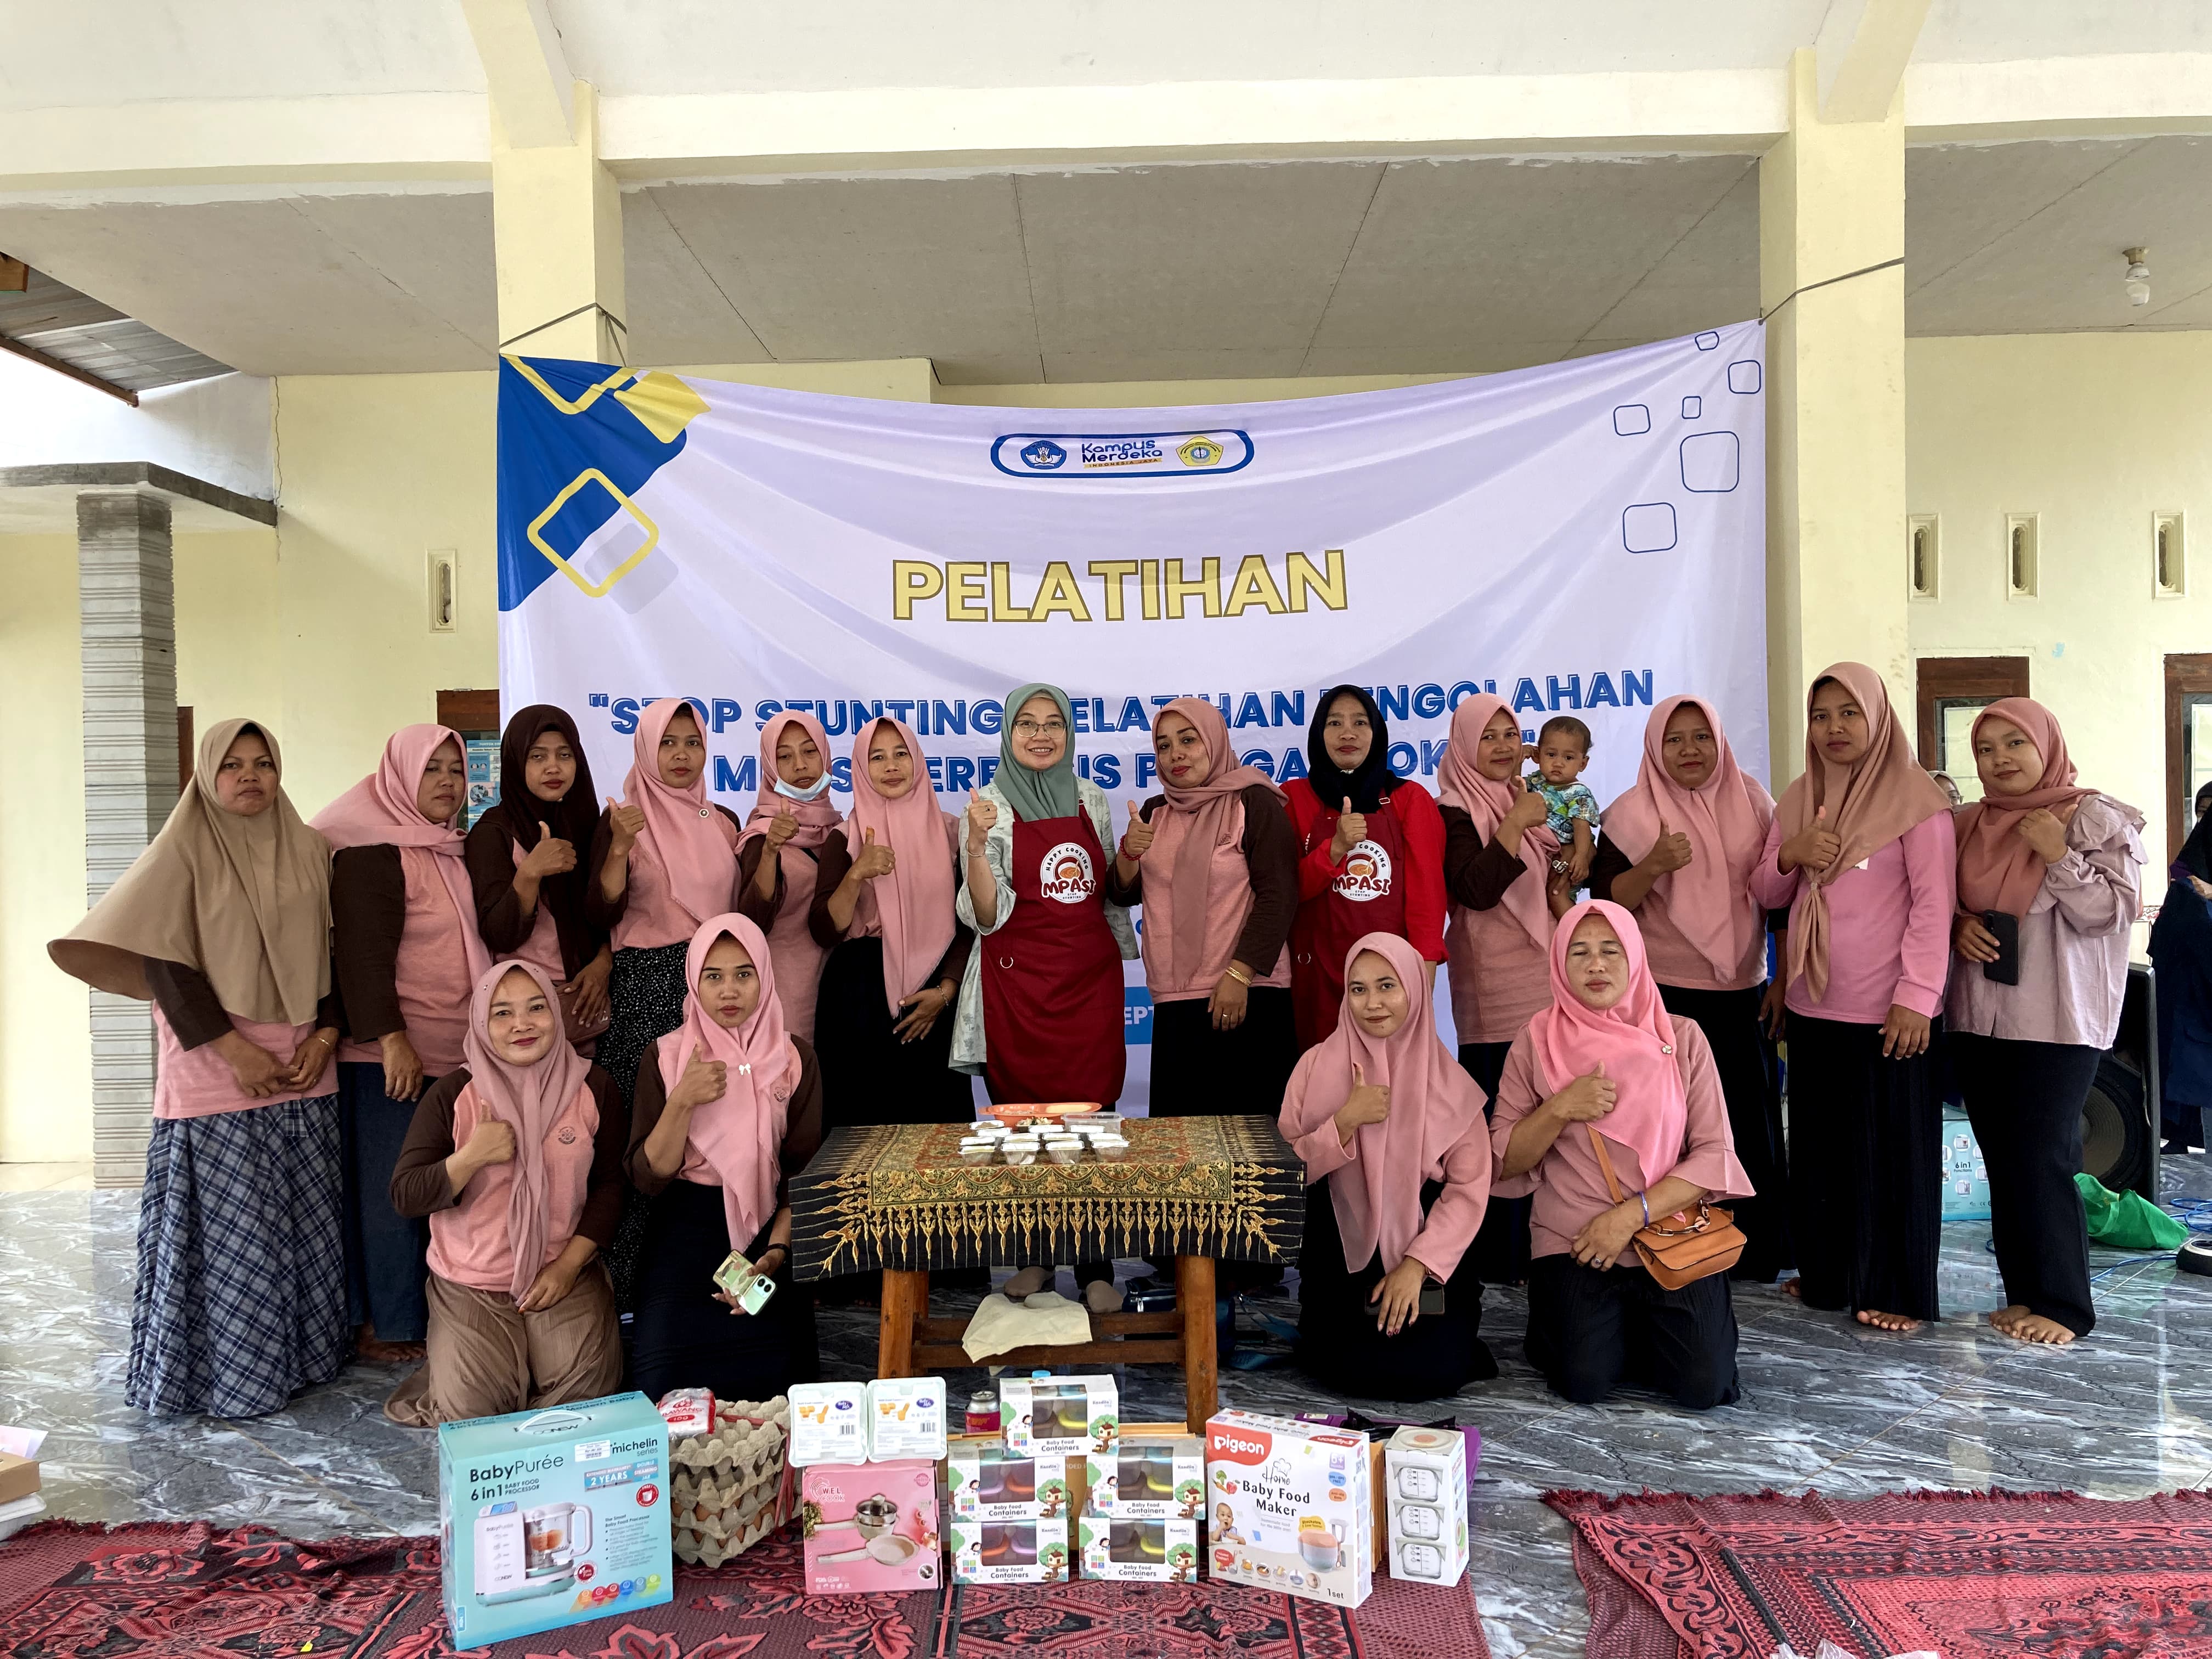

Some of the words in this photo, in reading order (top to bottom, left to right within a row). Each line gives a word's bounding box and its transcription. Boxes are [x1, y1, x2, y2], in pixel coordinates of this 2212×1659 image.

[1082, 440, 1155, 453] Kampus
[1082, 450, 1163, 463] Merdeka
[893, 549, 1348, 622] PELATIHAN
[589, 693, 742, 735] "SP
[1046, 850, 1062, 871] HAPPY
[1065, 847, 1088, 870] COOKING
[1359, 844, 1386, 868] COOKING
[1043, 878, 1095, 896] MPASI
[1334, 876, 1390, 894] MPASI
[612, 1437, 658, 1454] michelin
[637, 1447, 658, 1457] series
[1041, 1444, 1080, 1452] Containers
[1214, 1434, 1265, 1455] pigeon
[470, 1454, 564, 1482] BabyPurée
[1262, 1465, 1291, 1486] Home
[522, 1478, 539, 1486] FOOD
[591, 1477, 596, 1486] 2
[599, 1471, 628, 1484] YEARS
[505, 1484, 540, 1495] PROCESSOR
[819, 1494, 845, 1502] COOK
[1243, 1480, 1273, 1499] Baby
[1279, 1487, 1310, 1504] Food
[1256, 1498, 1297, 1516] Maker
[1327, 1588, 1331, 1596] 1
